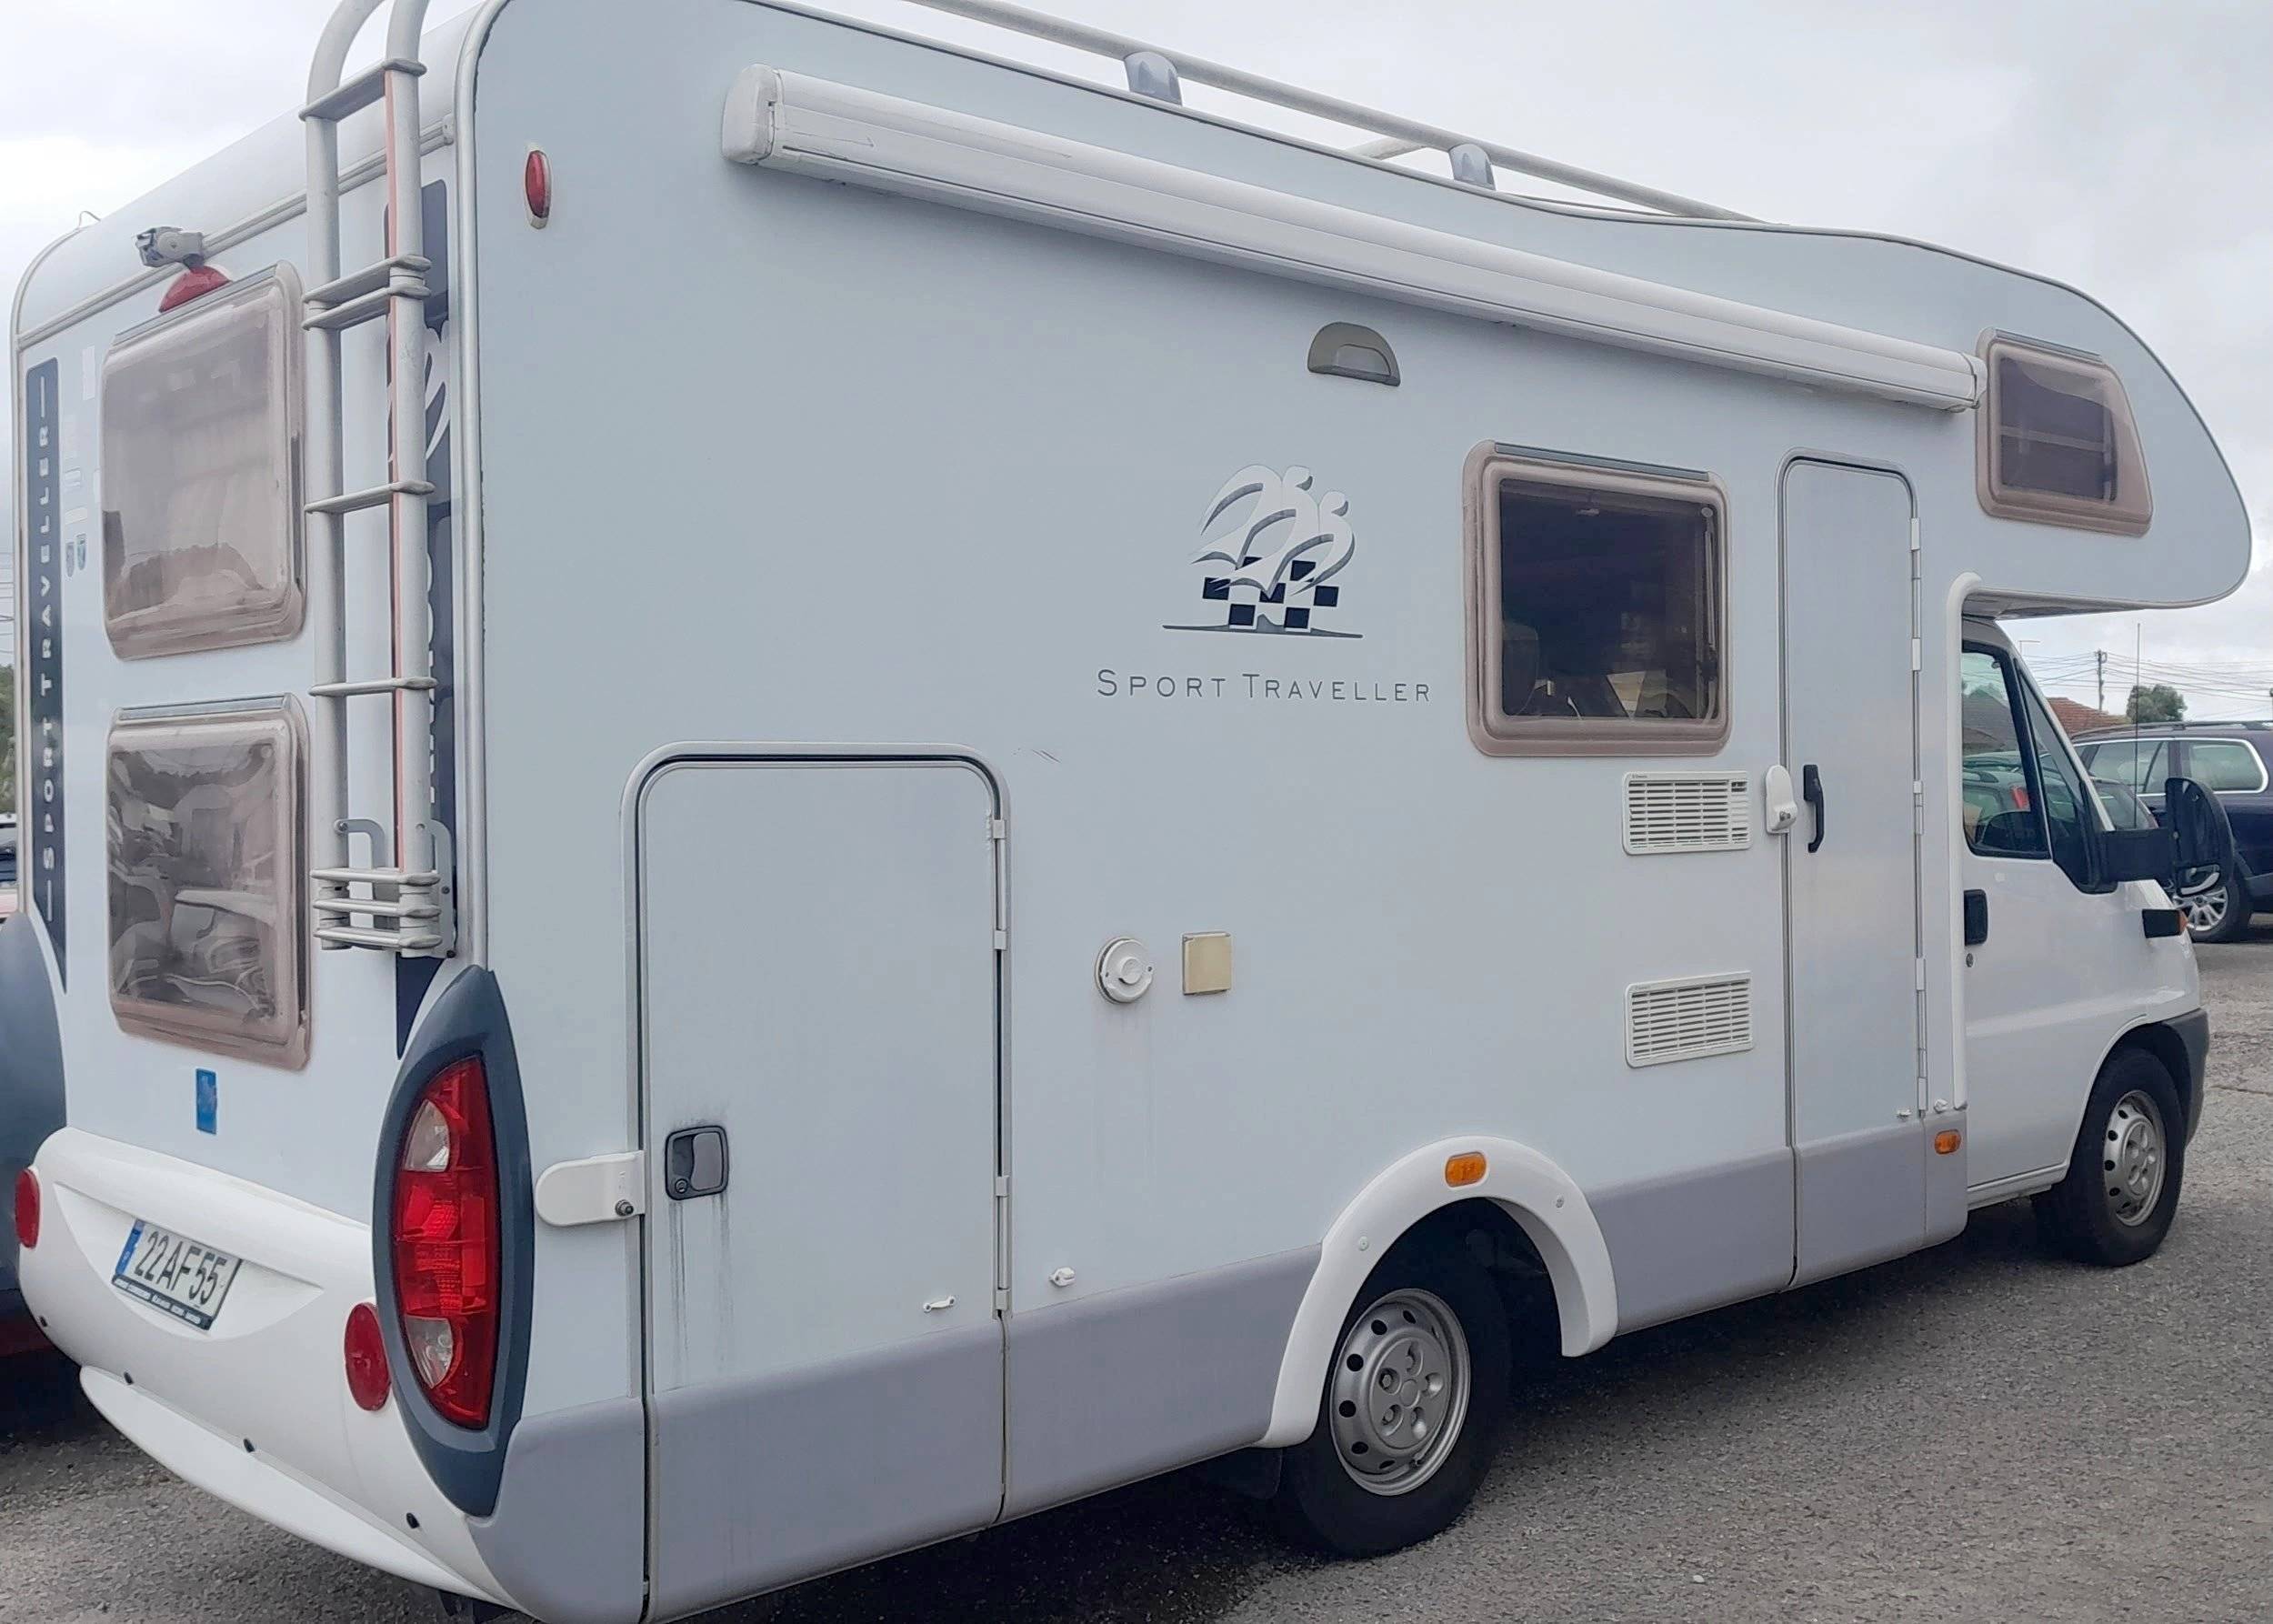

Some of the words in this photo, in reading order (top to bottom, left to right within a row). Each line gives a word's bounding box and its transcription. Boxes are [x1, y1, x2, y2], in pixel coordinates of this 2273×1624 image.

[39, 425, 53, 697] TRAVELLER
[1096, 668, 1227, 697] SPORT
[1242, 673, 1430, 702] TRAVELLER
[42, 717, 55, 870] SPORT
